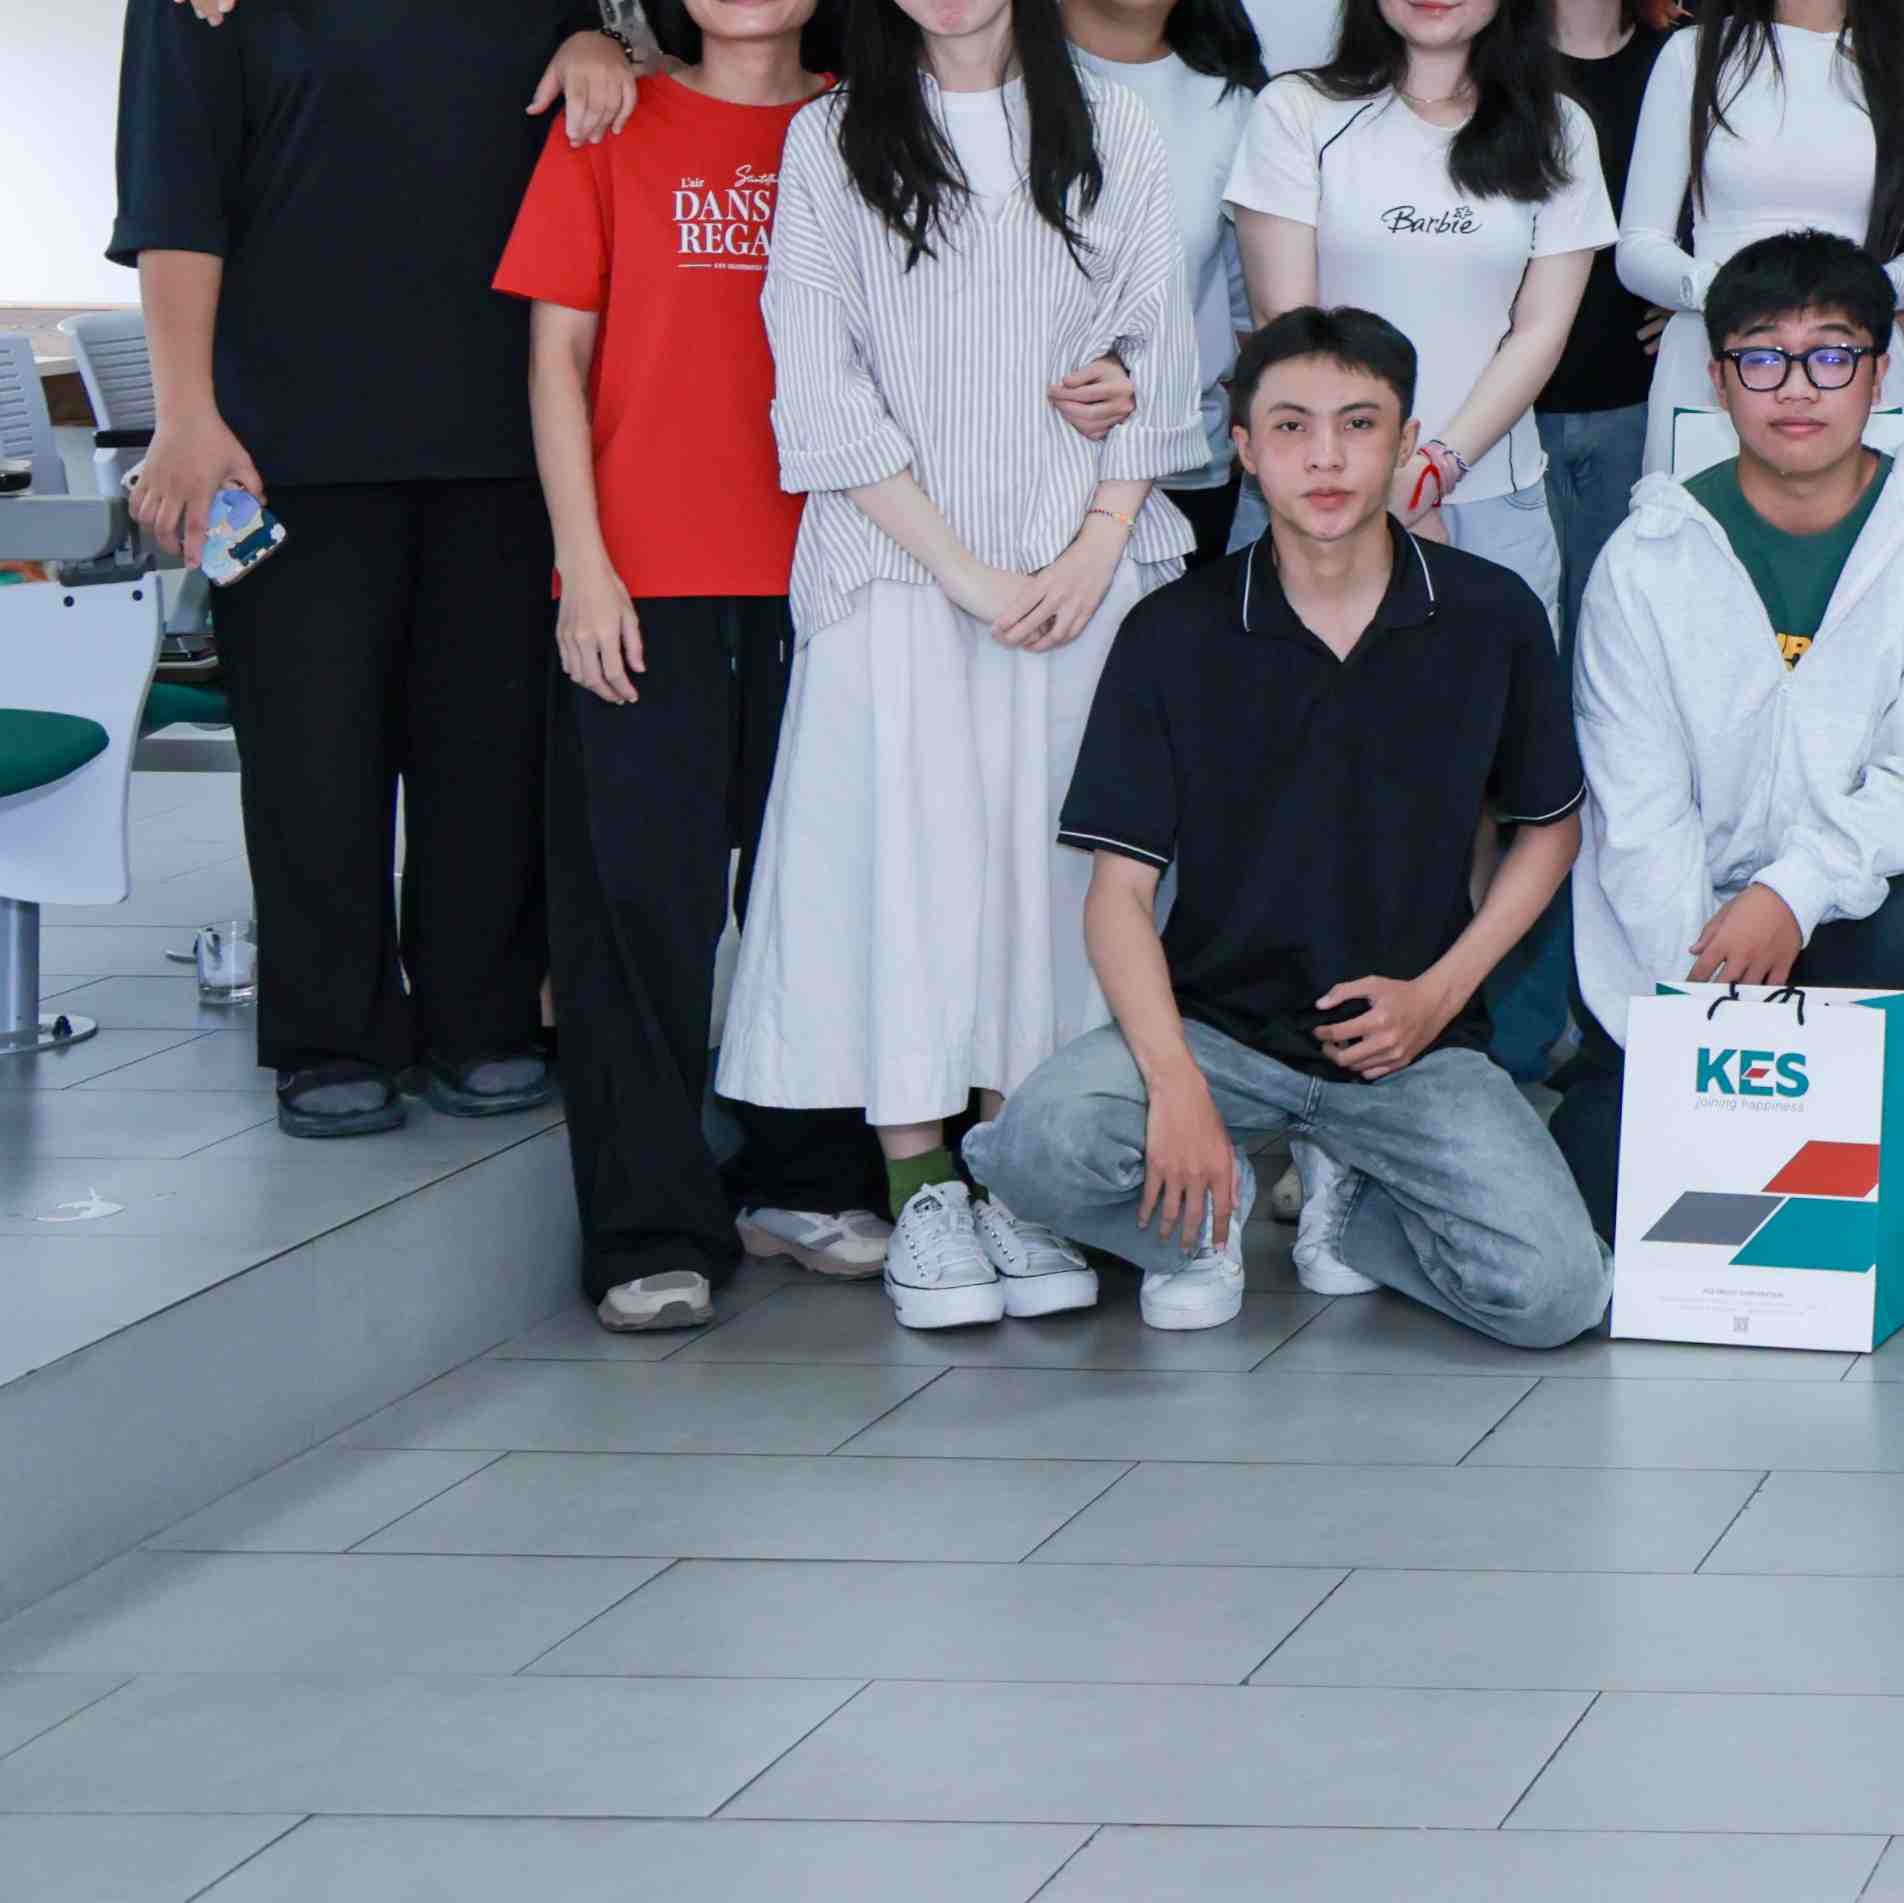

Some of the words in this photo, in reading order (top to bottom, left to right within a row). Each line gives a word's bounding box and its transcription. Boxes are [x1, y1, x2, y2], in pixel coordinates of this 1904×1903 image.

[672, 189, 770, 222] DANS
[1381, 205, 1482, 234] Barbie
[677, 223, 771, 256] REGA
[1695, 1048, 1809, 1097] KES
[1694, 1095, 1737, 1111] joining
[1741, 1097, 1804, 1114] happiness
